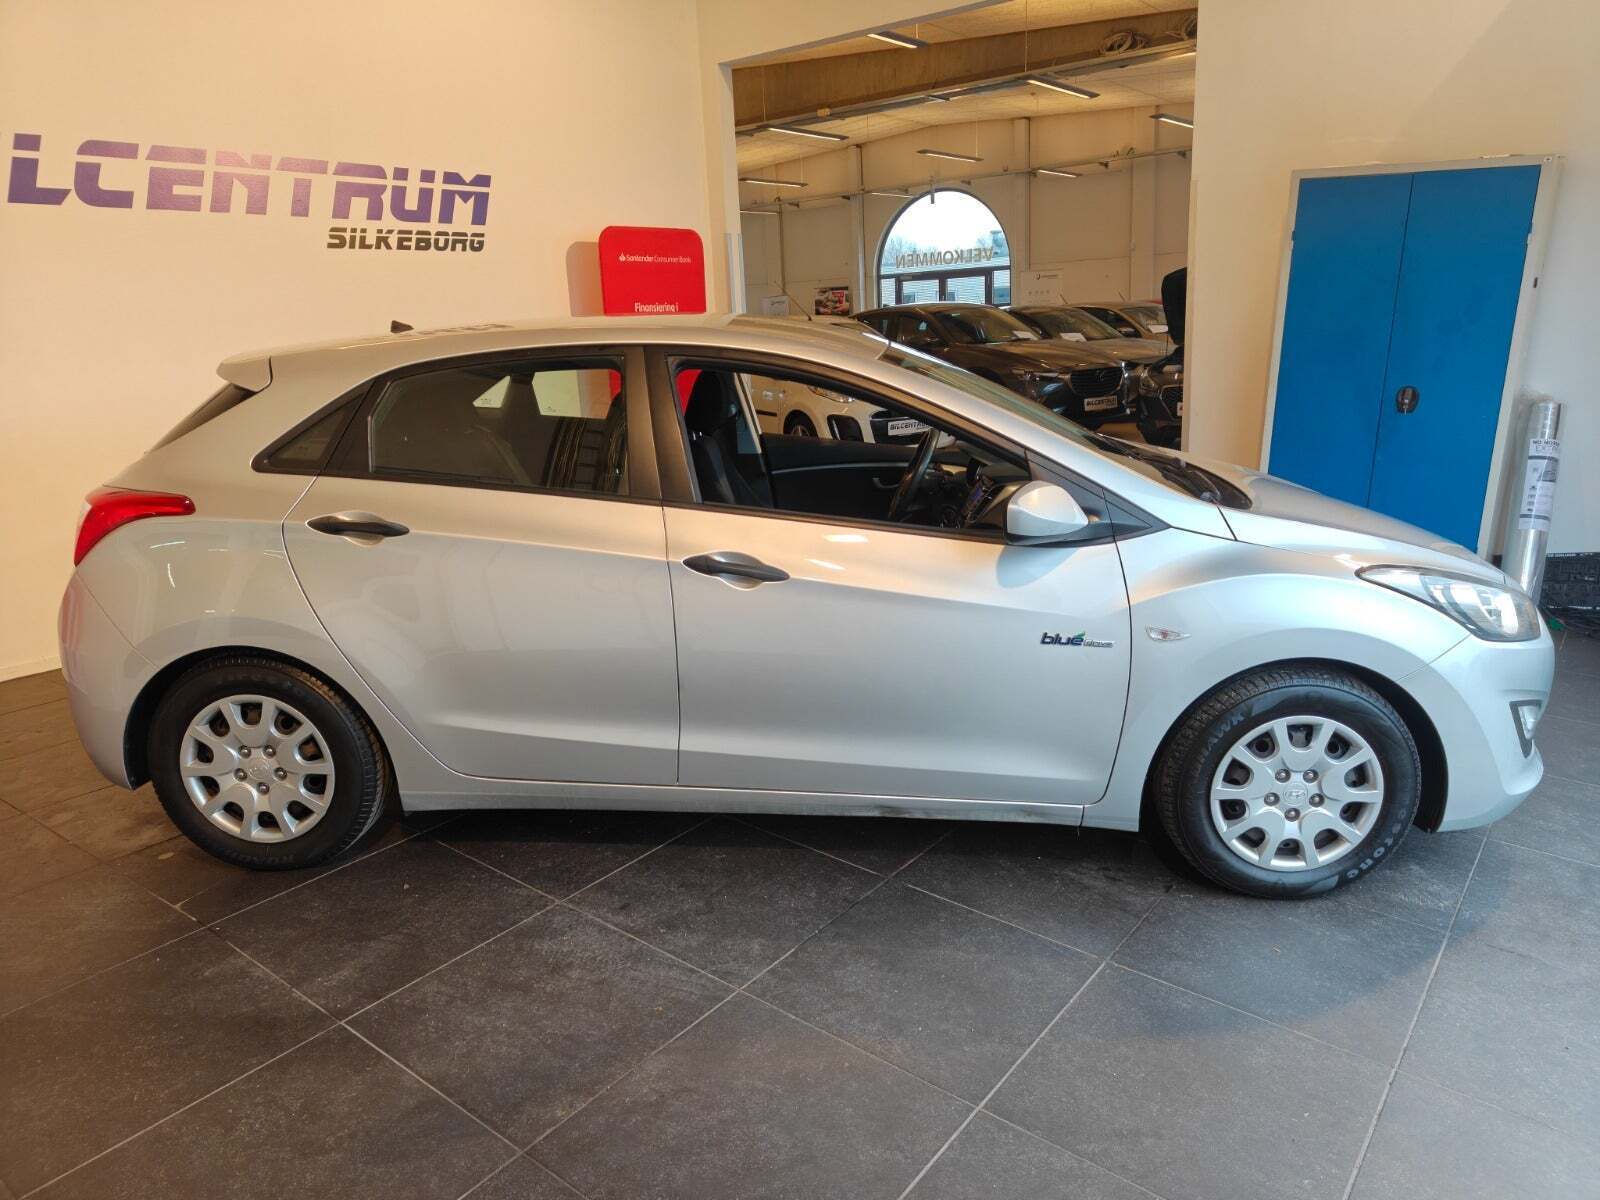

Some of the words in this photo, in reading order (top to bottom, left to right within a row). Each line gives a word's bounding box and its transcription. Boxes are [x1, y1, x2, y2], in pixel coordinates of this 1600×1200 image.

[6, 132, 492, 226] LCENTRUM
[327, 226, 486, 253] SILKEBORG
[626, 254, 653, 262] Santander
[1040, 631, 1085, 646] blue
